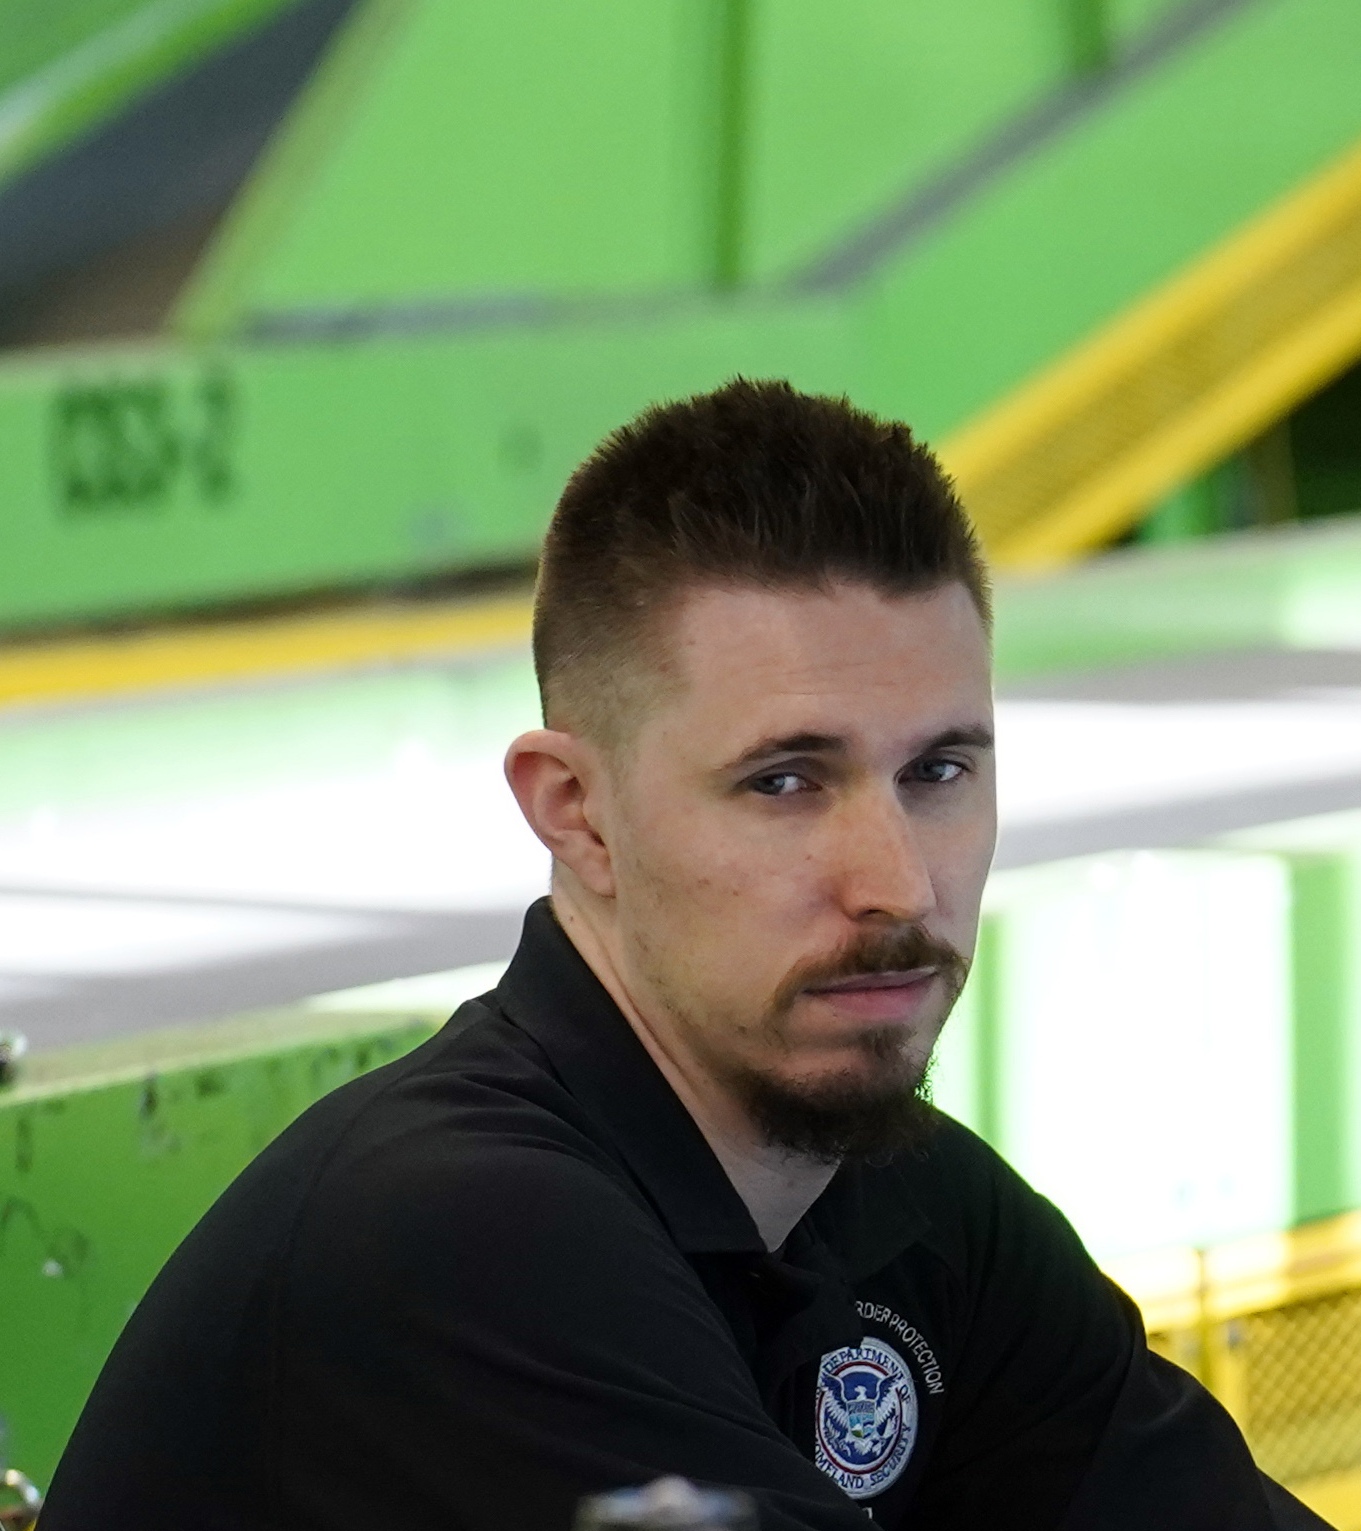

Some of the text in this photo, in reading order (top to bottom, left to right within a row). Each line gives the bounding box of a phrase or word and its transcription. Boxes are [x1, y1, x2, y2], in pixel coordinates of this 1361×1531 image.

[823, 1348, 911, 1404] DEPARTMENT OF
[889, 1313, 945, 1395] PROTECTION
[869, 1422, 911, 1487] SECURITY
